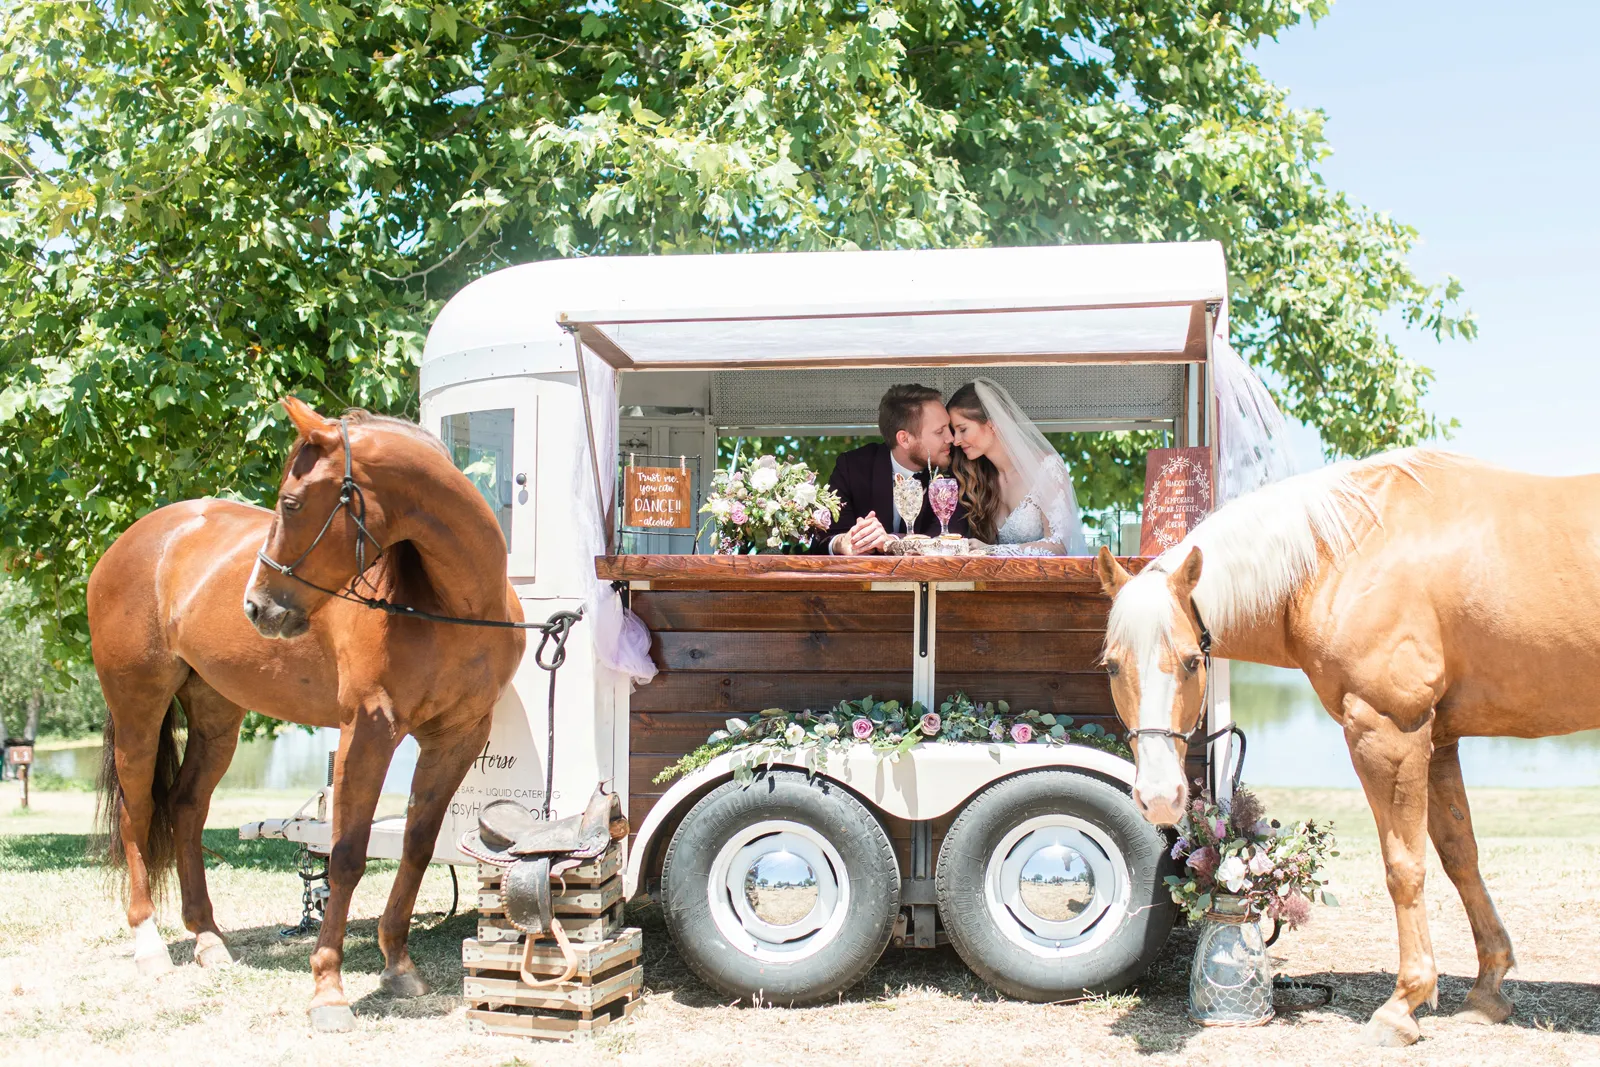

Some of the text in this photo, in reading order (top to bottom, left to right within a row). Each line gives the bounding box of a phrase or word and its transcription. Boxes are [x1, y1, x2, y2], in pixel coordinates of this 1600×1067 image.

[637, 472, 661, 482] Trust
[640, 484, 674, 495] you can
[634, 498, 681, 513] DANCE!!
[474, 741, 518, 774] Horse
[461, 786, 475, 795] BAR
[486, 787, 512, 798] LIQUID
[513, 789, 561, 800] CATERIG
[1106, 805, 1153, 861] POWER
[955, 875, 995, 955] HERCULES
